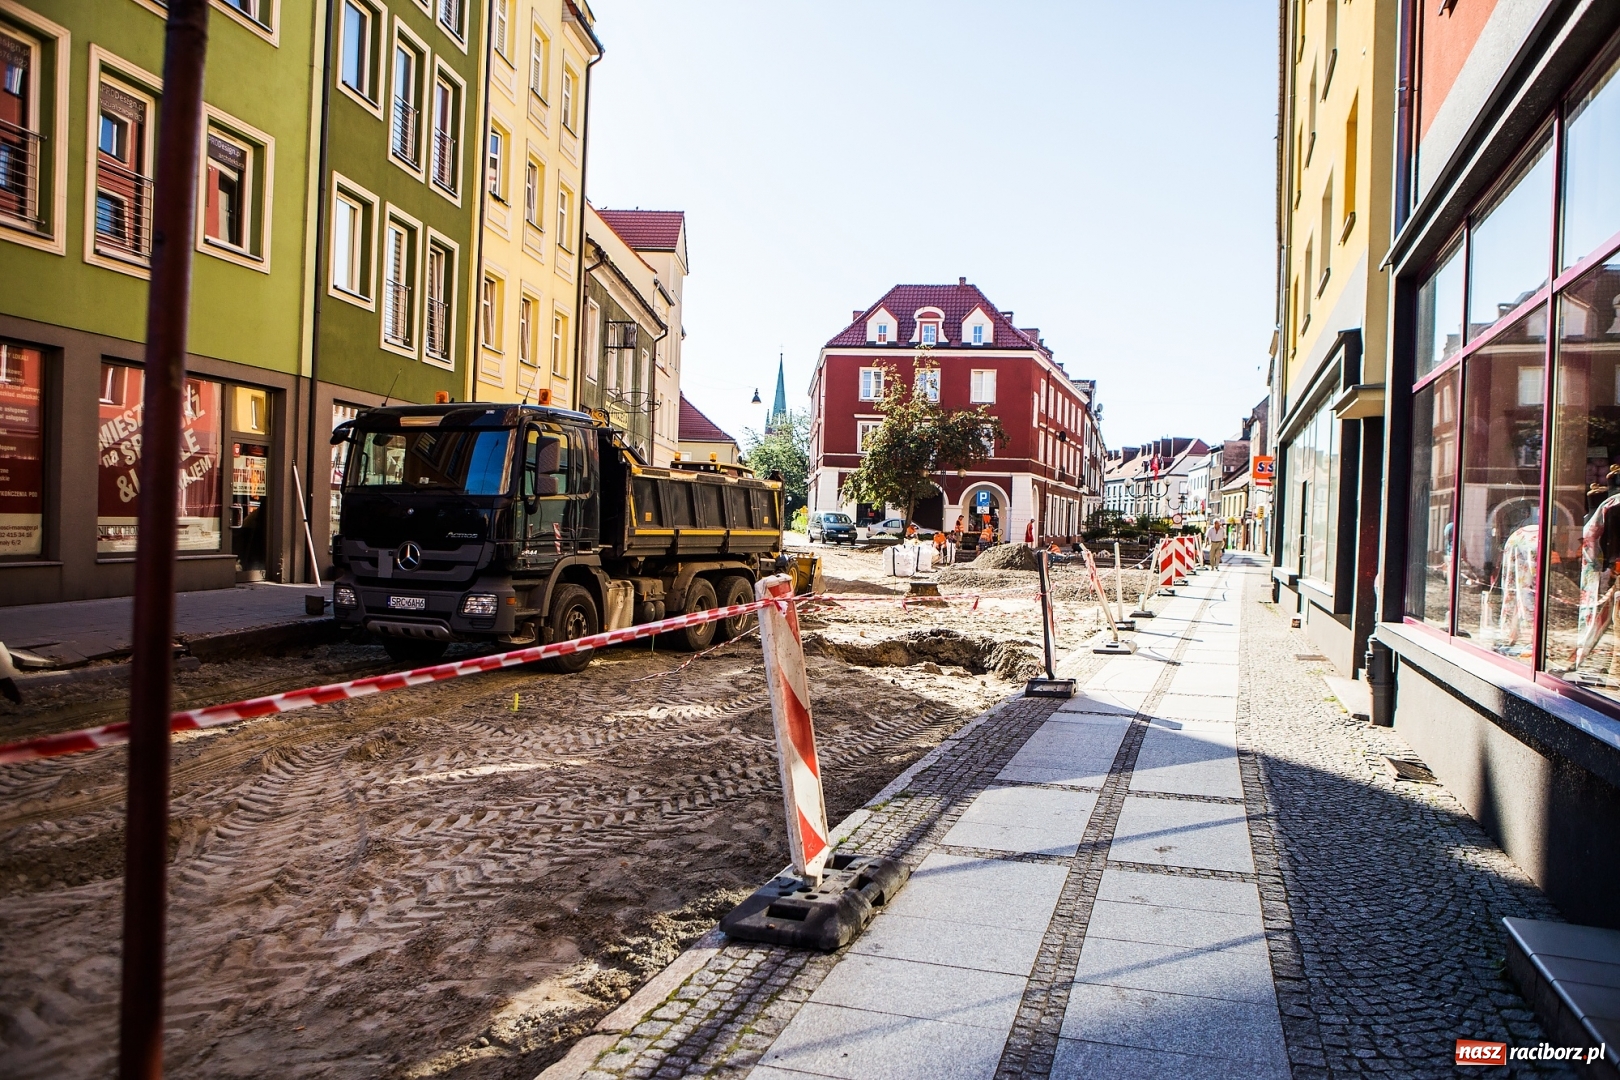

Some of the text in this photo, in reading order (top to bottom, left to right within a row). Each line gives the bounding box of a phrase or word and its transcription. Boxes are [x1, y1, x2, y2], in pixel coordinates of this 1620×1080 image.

[102, 449, 120, 469] na
[979, 492, 988, 503] P
[391, 597, 406, 607] SRC
